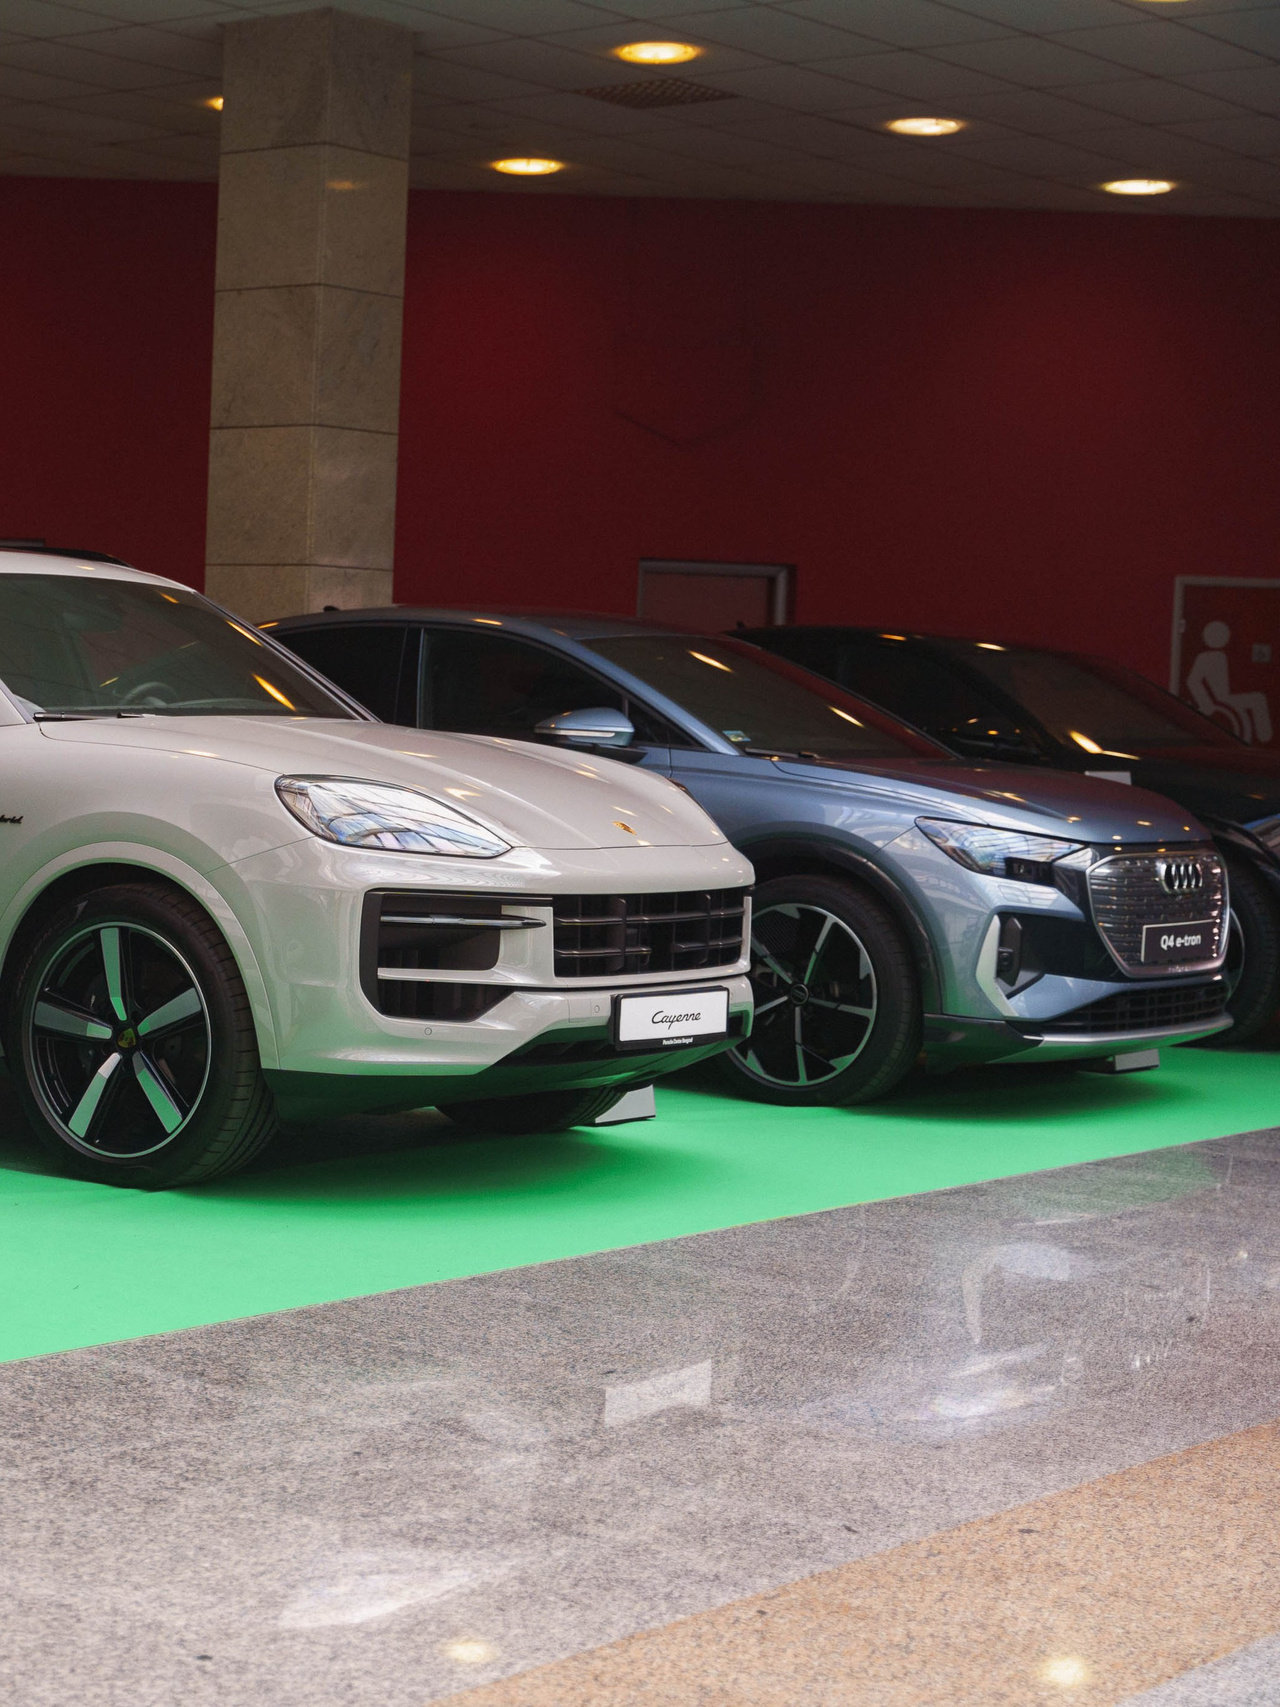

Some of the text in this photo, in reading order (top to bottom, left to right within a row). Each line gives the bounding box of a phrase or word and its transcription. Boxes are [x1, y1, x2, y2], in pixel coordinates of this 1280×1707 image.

[1160, 934, 1201, 950] Q4 e-tron
[651, 1010, 702, 1030] Cayenne
